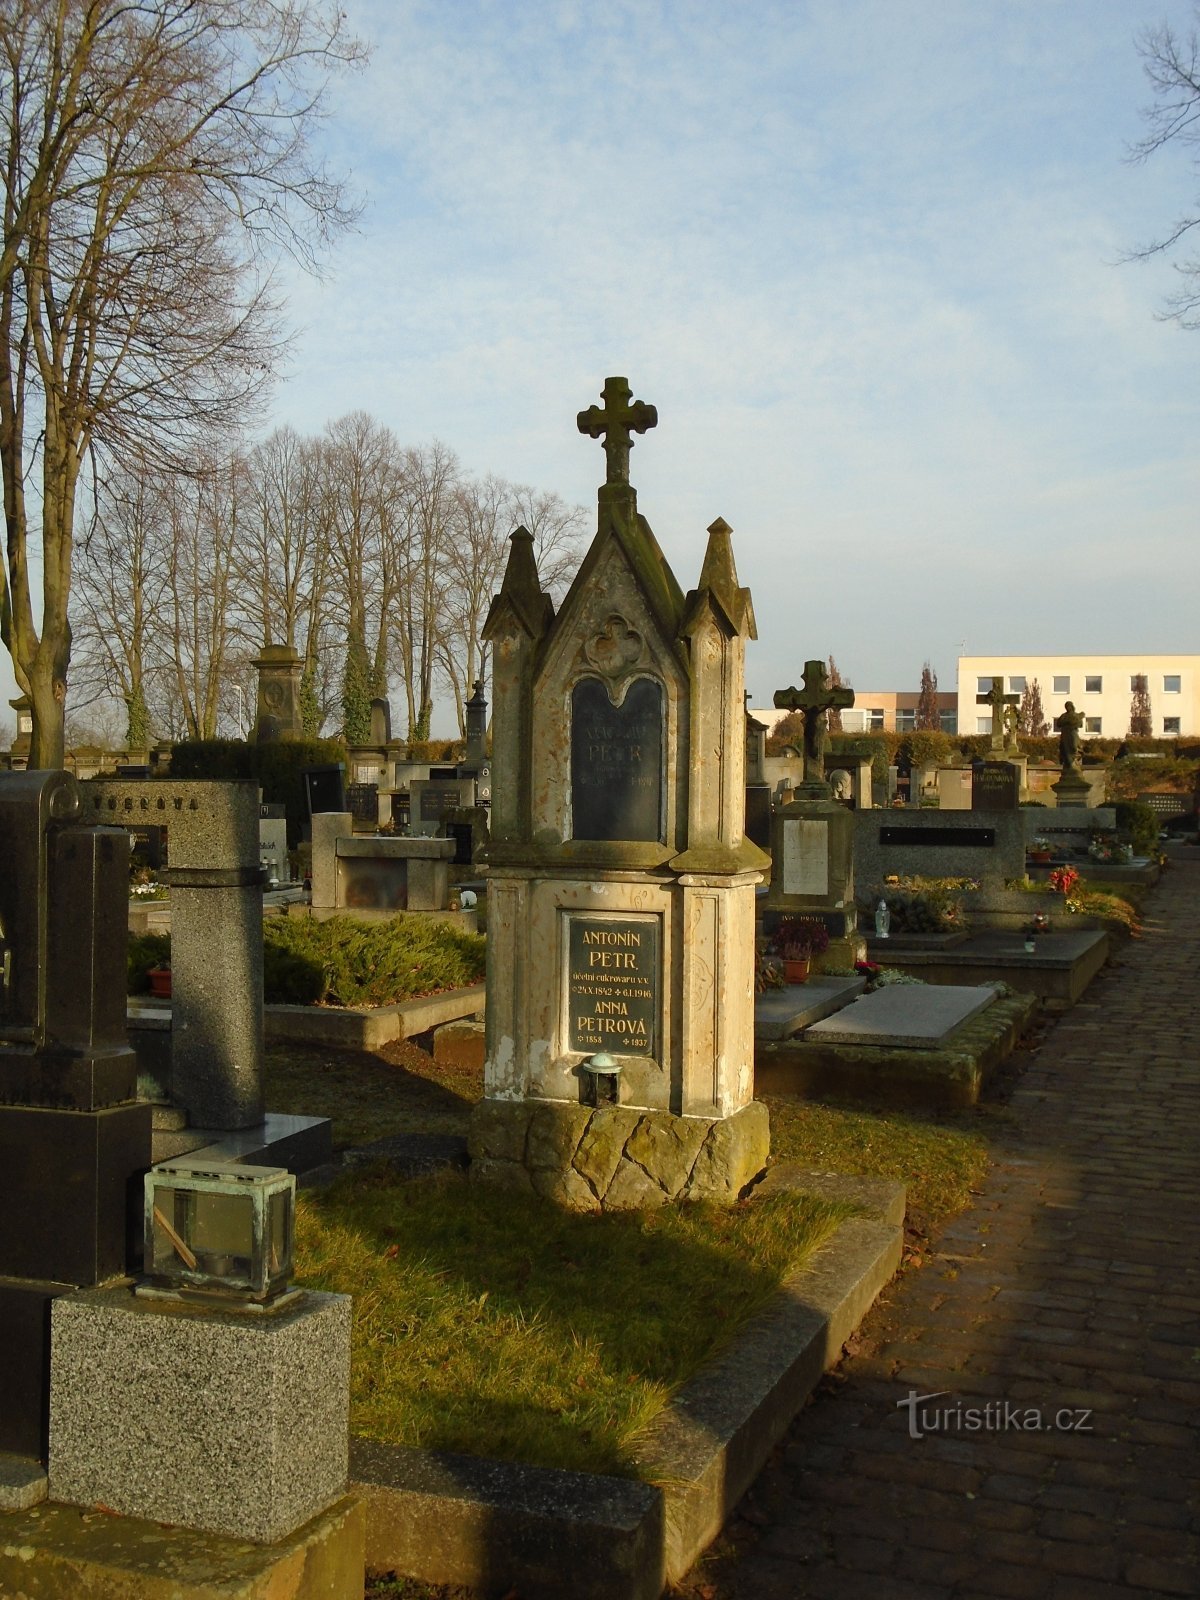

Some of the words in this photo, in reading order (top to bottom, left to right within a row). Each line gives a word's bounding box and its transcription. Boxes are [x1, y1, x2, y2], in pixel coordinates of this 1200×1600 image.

[582, 930, 641, 947] ANTONÍN
[594, 1001, 629, 1015] ANNA
[577, 1016, 647, 1035] PETROVÁ
